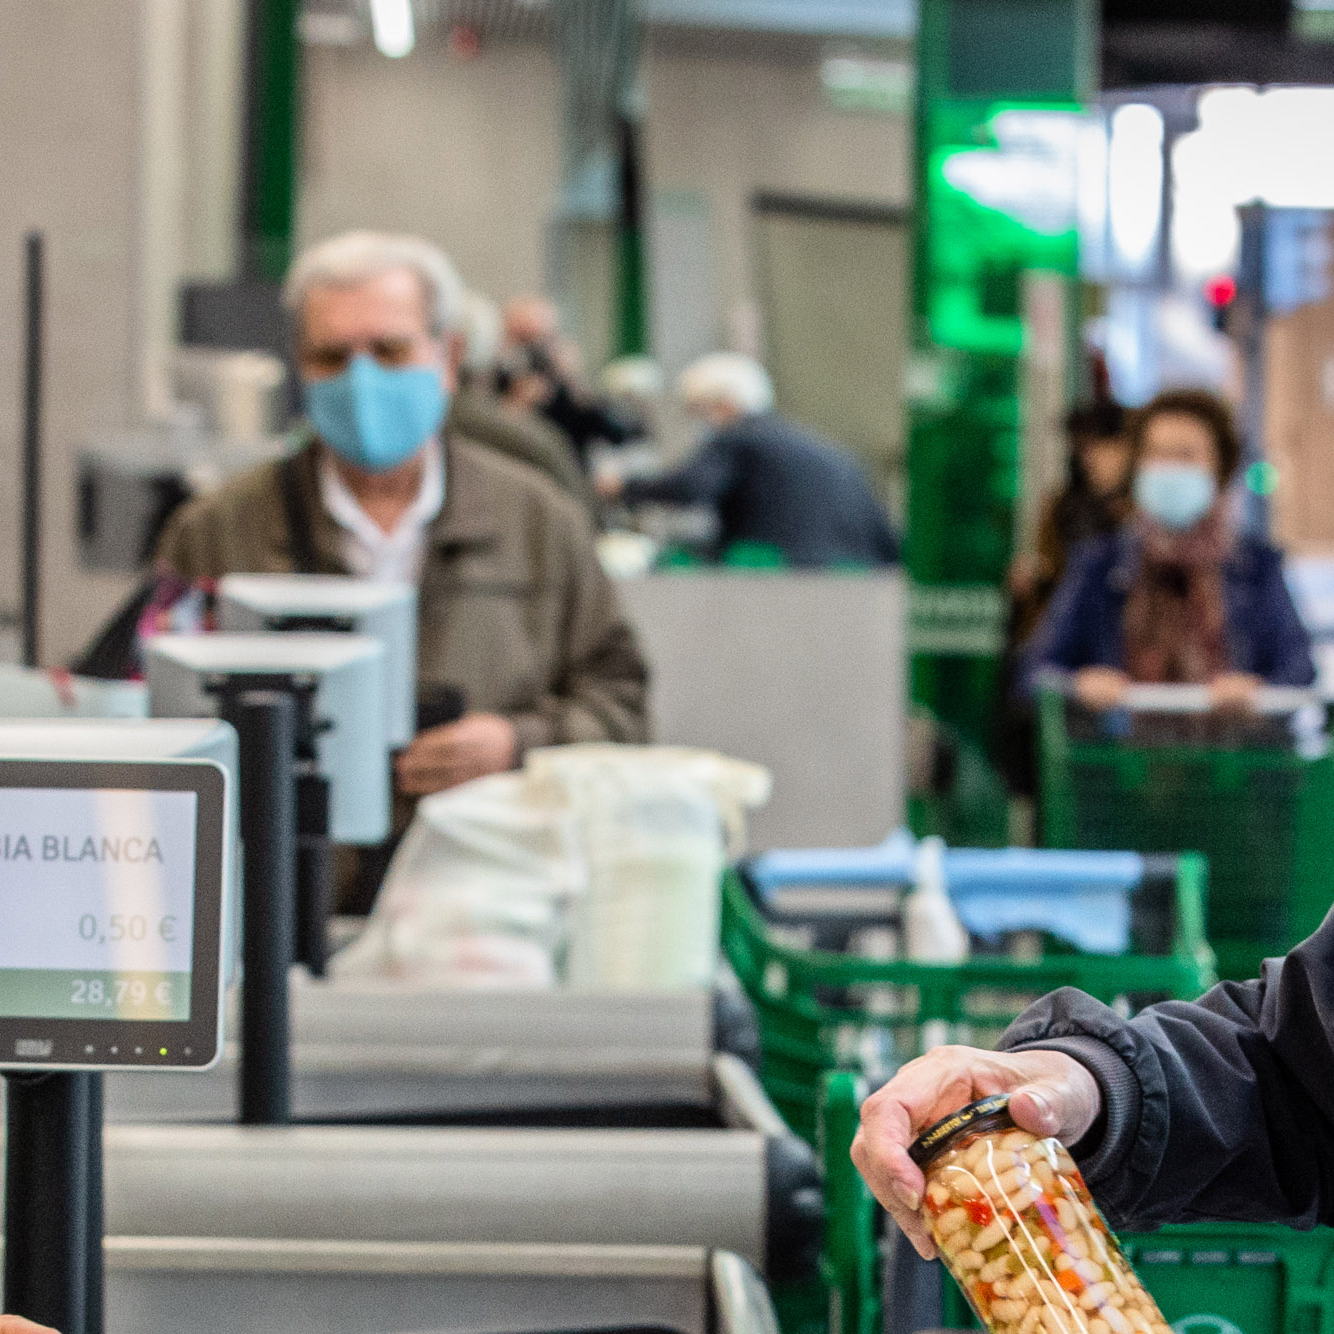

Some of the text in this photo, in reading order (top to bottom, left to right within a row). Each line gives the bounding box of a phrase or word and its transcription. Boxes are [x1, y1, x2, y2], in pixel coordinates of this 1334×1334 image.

[41, 834, 165, 865] BLANCA
[78, 912, 178, 945] 0,50 €
[69, 979, 148, 1007] 28,79
